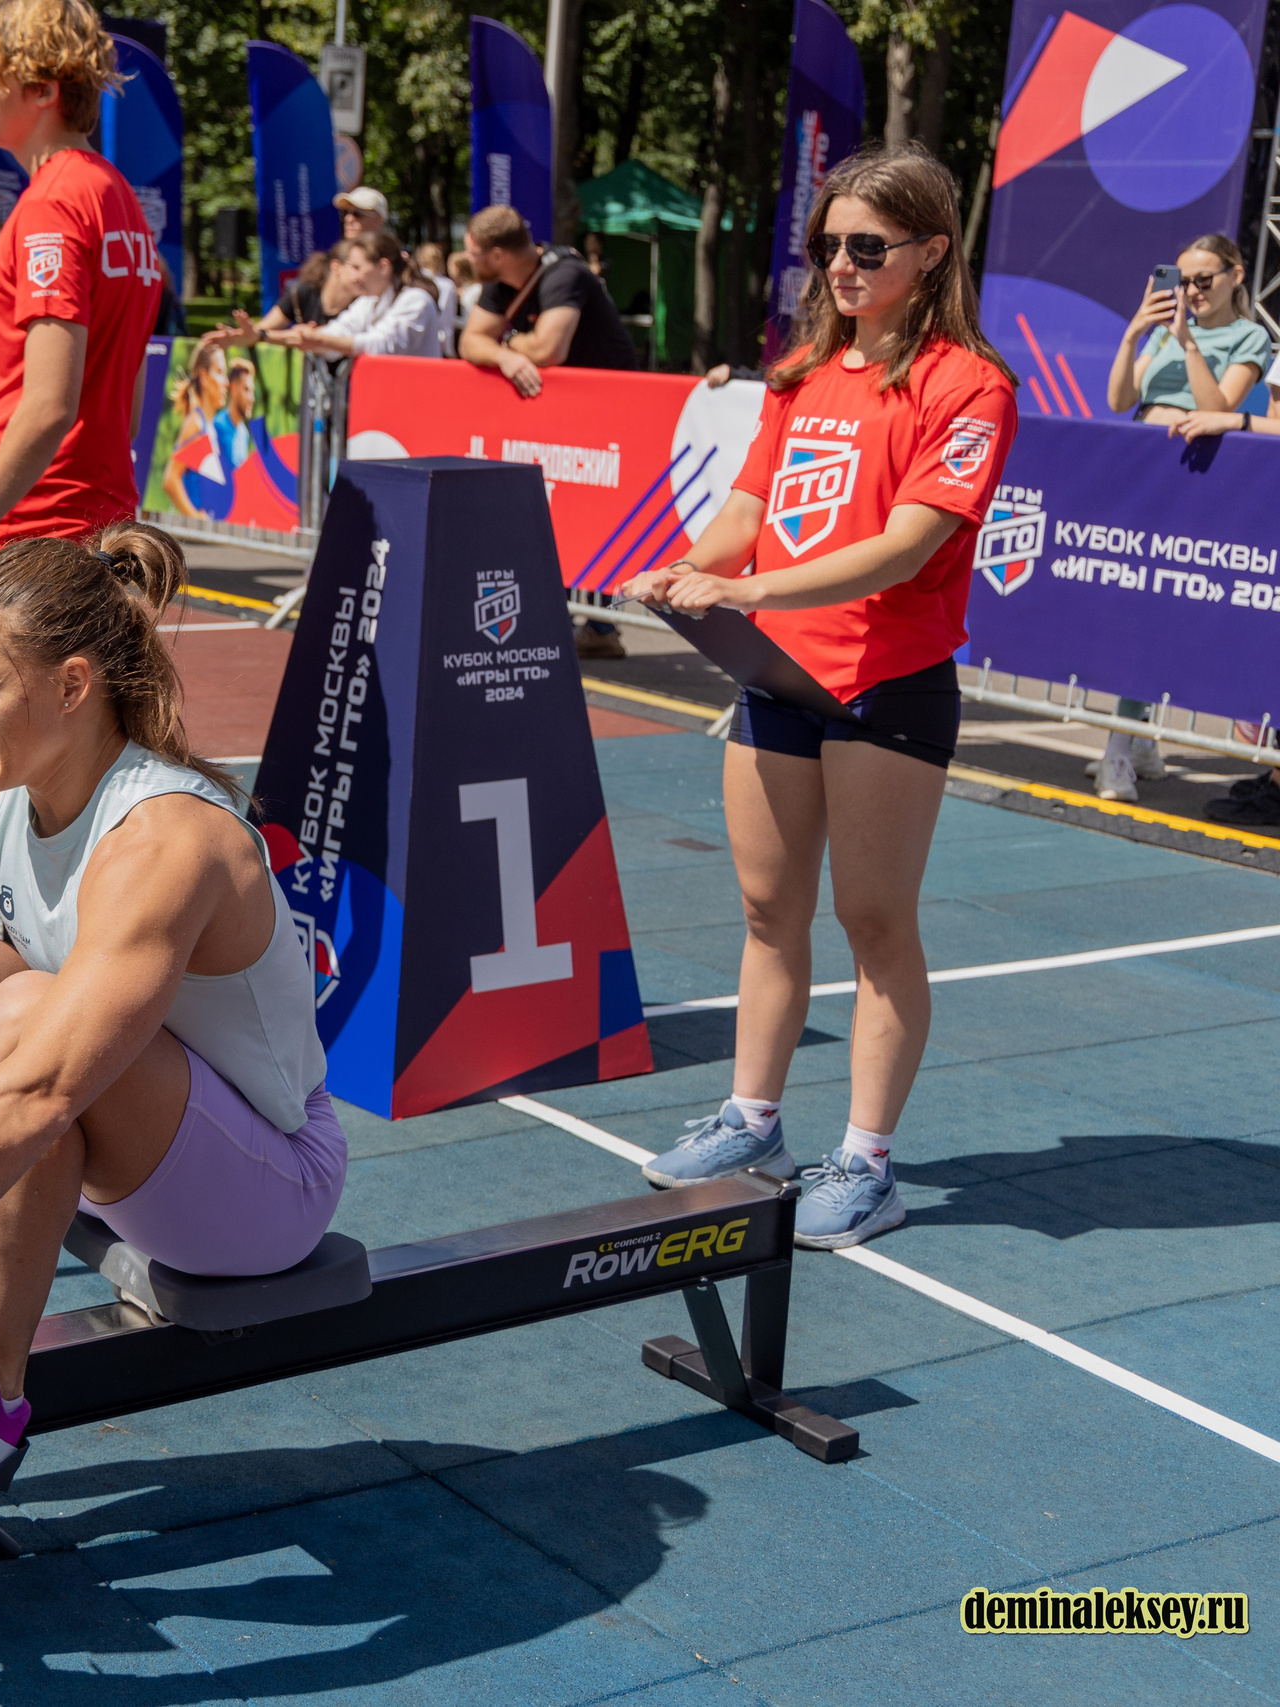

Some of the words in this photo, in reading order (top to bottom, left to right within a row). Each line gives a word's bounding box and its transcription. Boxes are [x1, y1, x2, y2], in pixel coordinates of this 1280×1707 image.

[32, 254, 57, 273] ГТО
[790, 416, 861, 437] ИГРЫ
[948, 444, 983, 459] ГТО
[776, 465, 844, 512] ГТО
[938, 475, 975, 491] РОССИИ
[982, 524, 1037, 559] ГТО
[1054, 519, 1147, 558] КУБОК
[1149, 532, 1279, 576] МОСКВЫ
[476, 569, 515, 581] ИГРЫ
[1050, 554, 1148, 592] «ИГРЫ
[1152, 567, 1226, 604] ГТО»
[1230, 578, 1280, 613] 202
[481, 593, 514, 622] ГТО
[443, 651, 494, 669] КУБОК
[496, 646, 561, 665] МОСКВЫ
[456, 669, 510, 686] «ИГРЫ
[513, 666, 551, 681] ГТО»
[485, 686, 524, 702] 2024
[319, 761, 355, 902] «ИГРЫ
[339, 653, 371, 772] ГТО»
[356, 538, 391, 644] 2024
[291, 764, 329, 894] КУБОК
[313, 586, 357, 757] МОСКВЫ
[458, 777, 574, 994] 1
[613, 1233, 654, 1249] concept
[655, 1232, 662, 1241] 2
